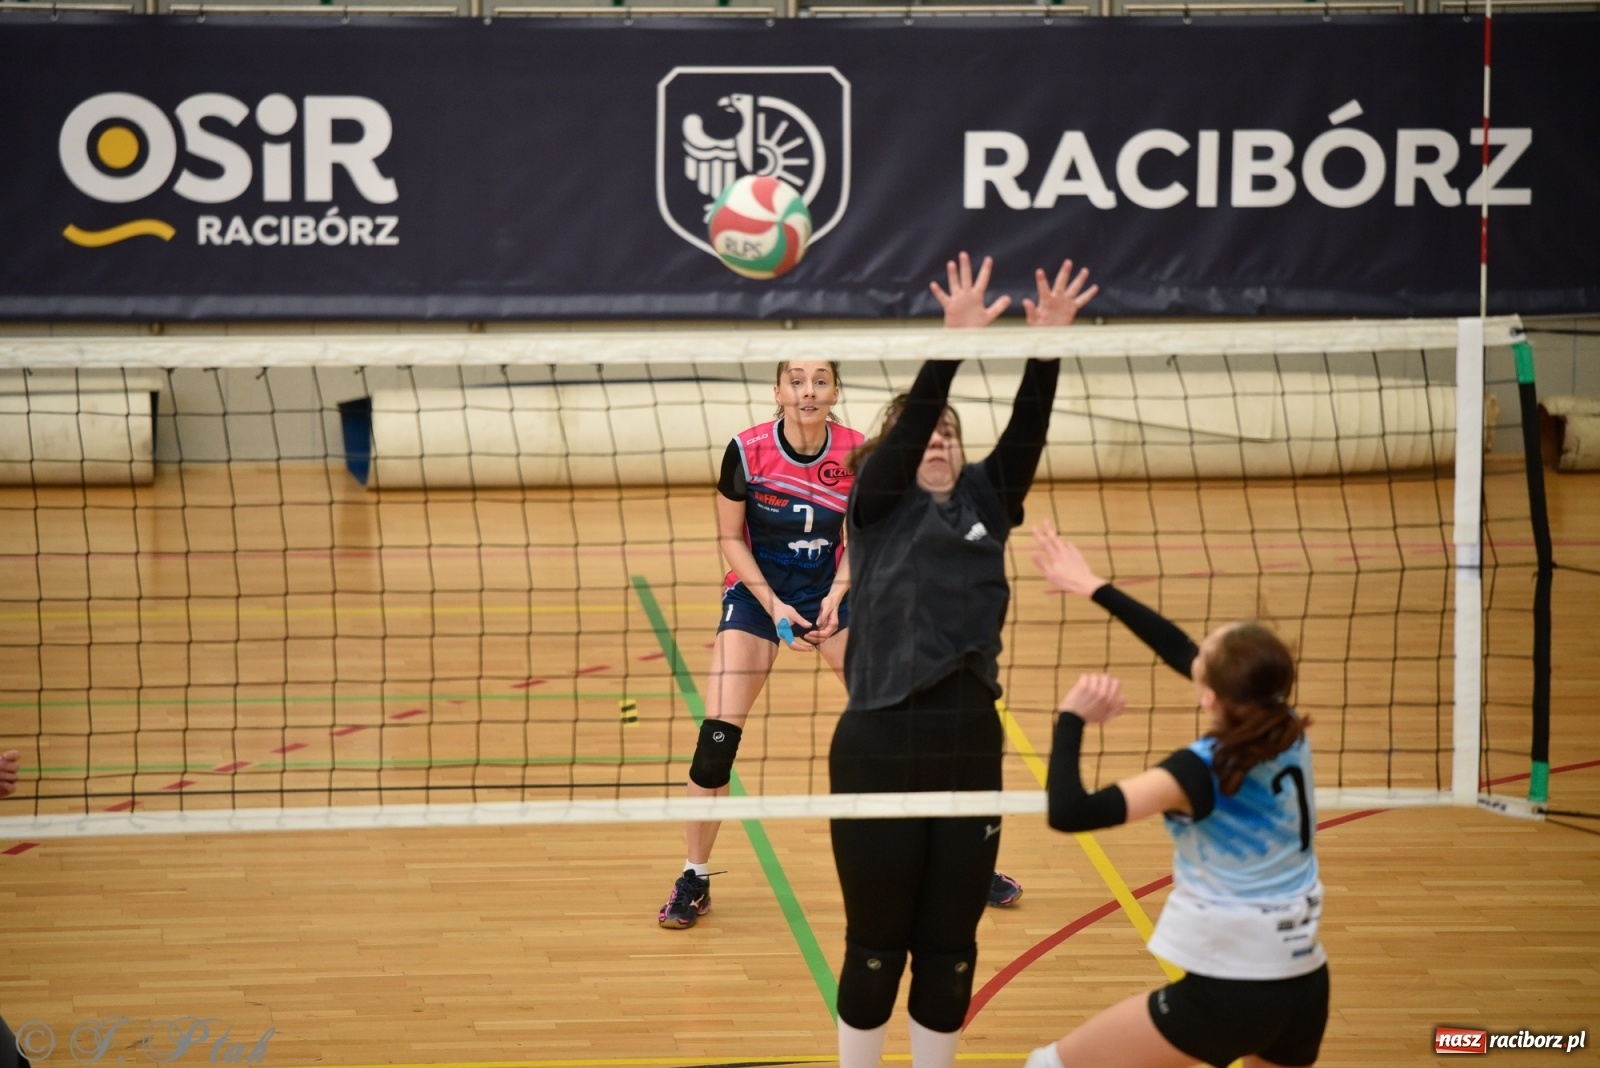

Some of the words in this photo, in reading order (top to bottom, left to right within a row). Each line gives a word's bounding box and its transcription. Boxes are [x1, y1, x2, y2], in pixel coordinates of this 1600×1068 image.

[963, 99, 1533, 210] RACIBÓRZ
[197, 206, 399, 246] RACIBÓRZ
[793, 504, 814, 533] 7
